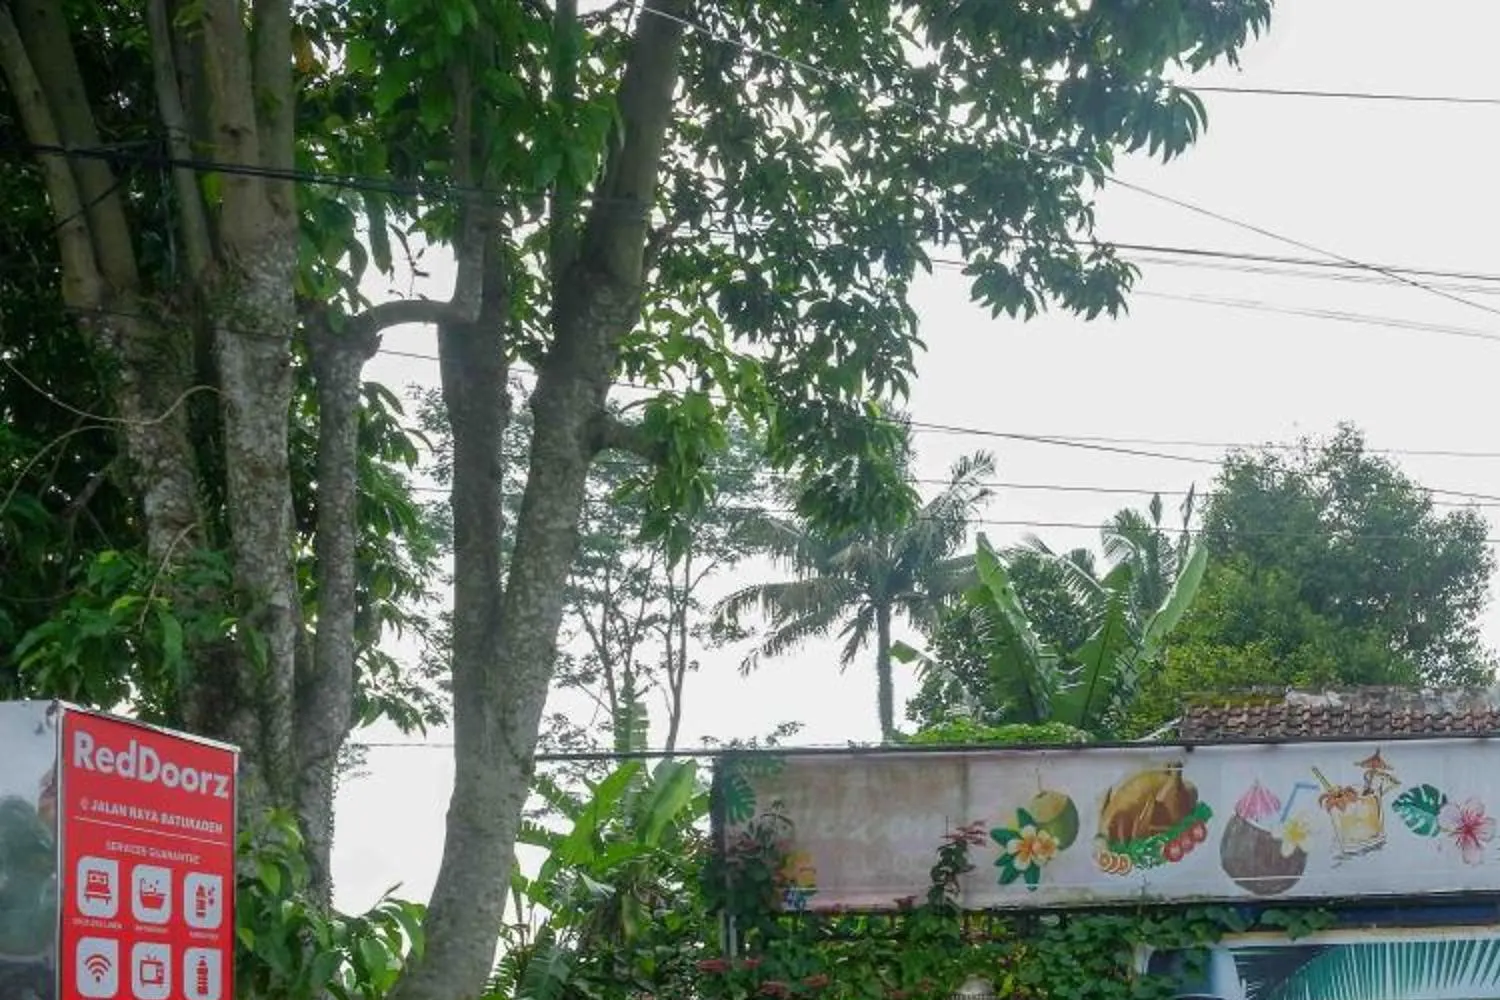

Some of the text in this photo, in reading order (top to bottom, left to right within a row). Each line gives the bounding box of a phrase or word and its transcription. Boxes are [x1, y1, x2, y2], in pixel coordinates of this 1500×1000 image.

[74, 731, 229, 798] RedDoorz
[91, 799, 128, 817] JALAN
[128, 806, 159, 823] RAYA
